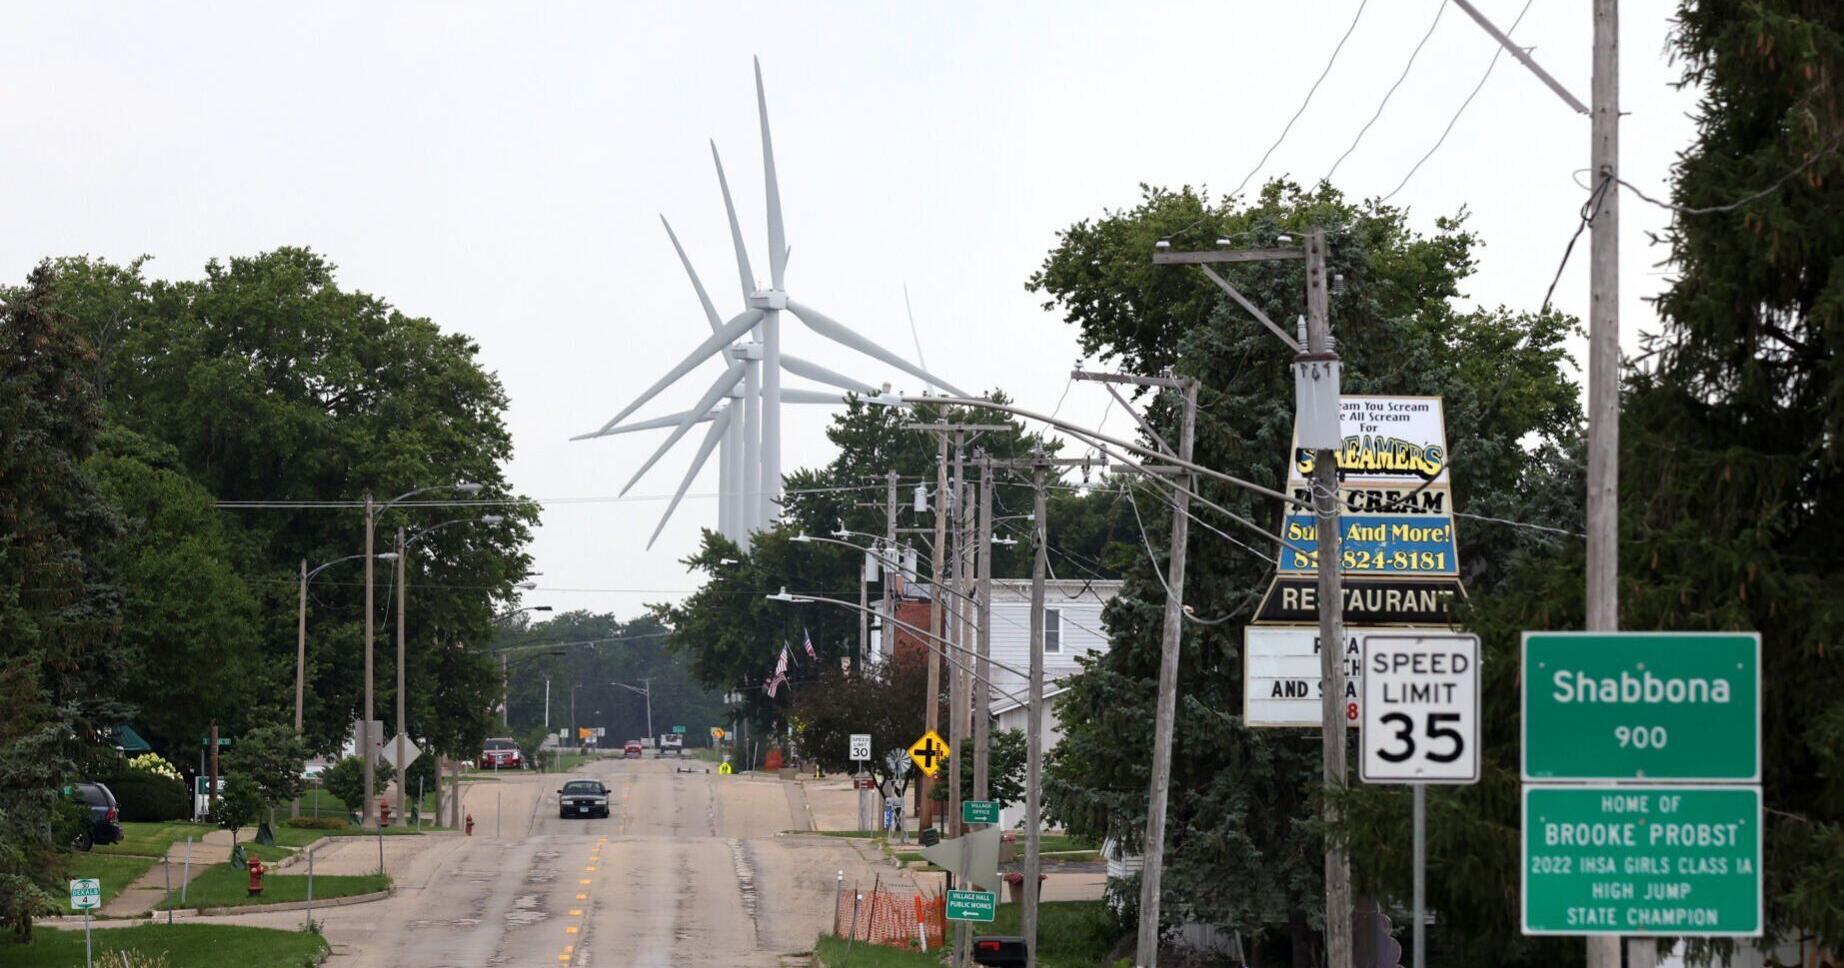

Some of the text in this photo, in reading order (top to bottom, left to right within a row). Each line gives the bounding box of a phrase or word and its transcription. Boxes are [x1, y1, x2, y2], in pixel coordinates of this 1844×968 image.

[1365, 402, 1383, 411] You
[1388, 402, 1429, 412] Scream
[1350, 413, 1365, 421] All
[1369, 413, 1410, 422] Scream
[1360, 423, 1379, 432] For
[1347, 491, 1445, 514] CREAM
[1346, 523, 1387, 542] And
[1391, 524, 1451, 543] More!
[1282, 587, 1454, 613] RETAURANT
[1373, 652, 1469, 674] SPEED
[1271, 681, 1308, 698] AND
[1383, 683, 1457, 704] LIMIT
[1553, 669, 1731, 703] Shabbona
[1376, 711, 1465, 763] 35
[1614, 725, 1667, 749] 900
[852, 747, 868, 757] 30
[1601, 795, 1682, 813] HOME OF
[1545, 823, 1738, 847] BROOKE PROBST
[1532, 856, 1572, 874] 2022
[1580, 857, 1616, 874] IHSA
[1624, 857, 1670, 874] GIRLS
[1678, 857, 1728, 874] CLASS
[1592, 882, 1692, 900] HIGH JUMP
[950, 900, 970, 908] PUBLIC
[1567, 908, 1719, 926] STATE CHAMPION
